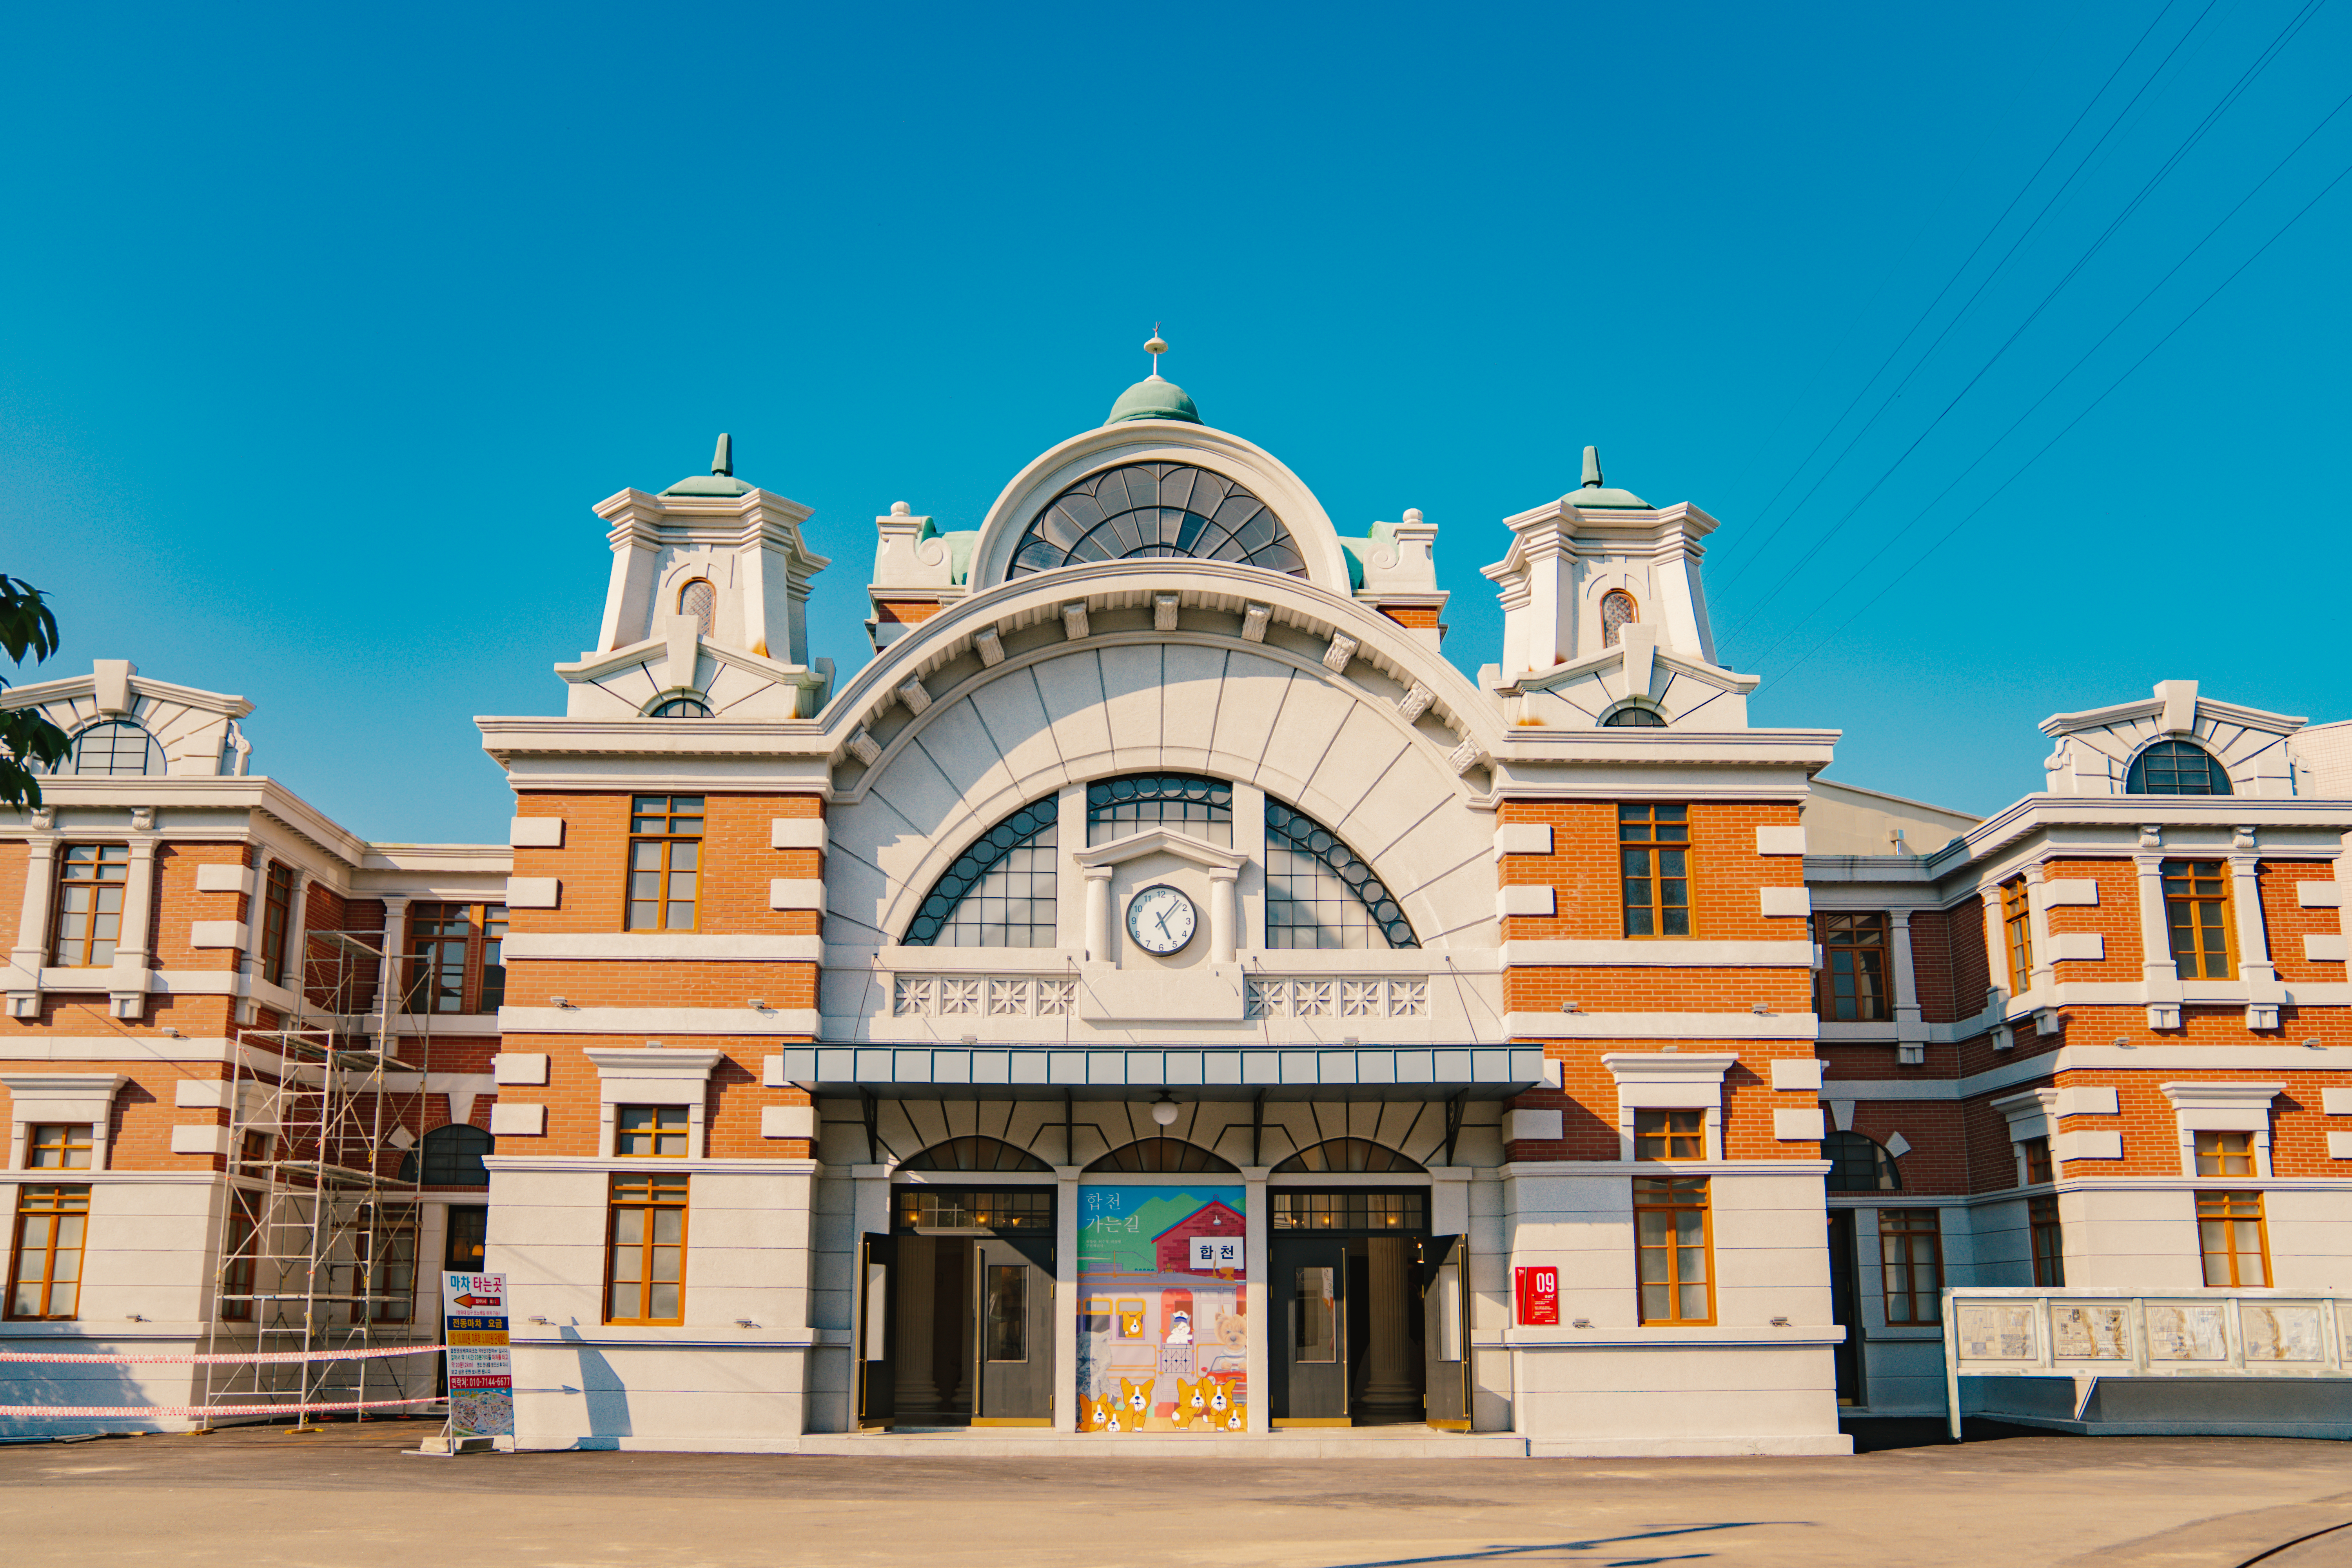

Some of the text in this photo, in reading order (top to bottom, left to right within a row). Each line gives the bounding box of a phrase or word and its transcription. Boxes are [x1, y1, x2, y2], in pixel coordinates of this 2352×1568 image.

[450, 1276, 502, 1292] 마차 타는곳
[1536, 1273, 1554, 1292] 09
[453, 1318, 502, 1328] 전동마차 요금
[451, 1377, 510, 1388] 연락처: 010-7144-6677
